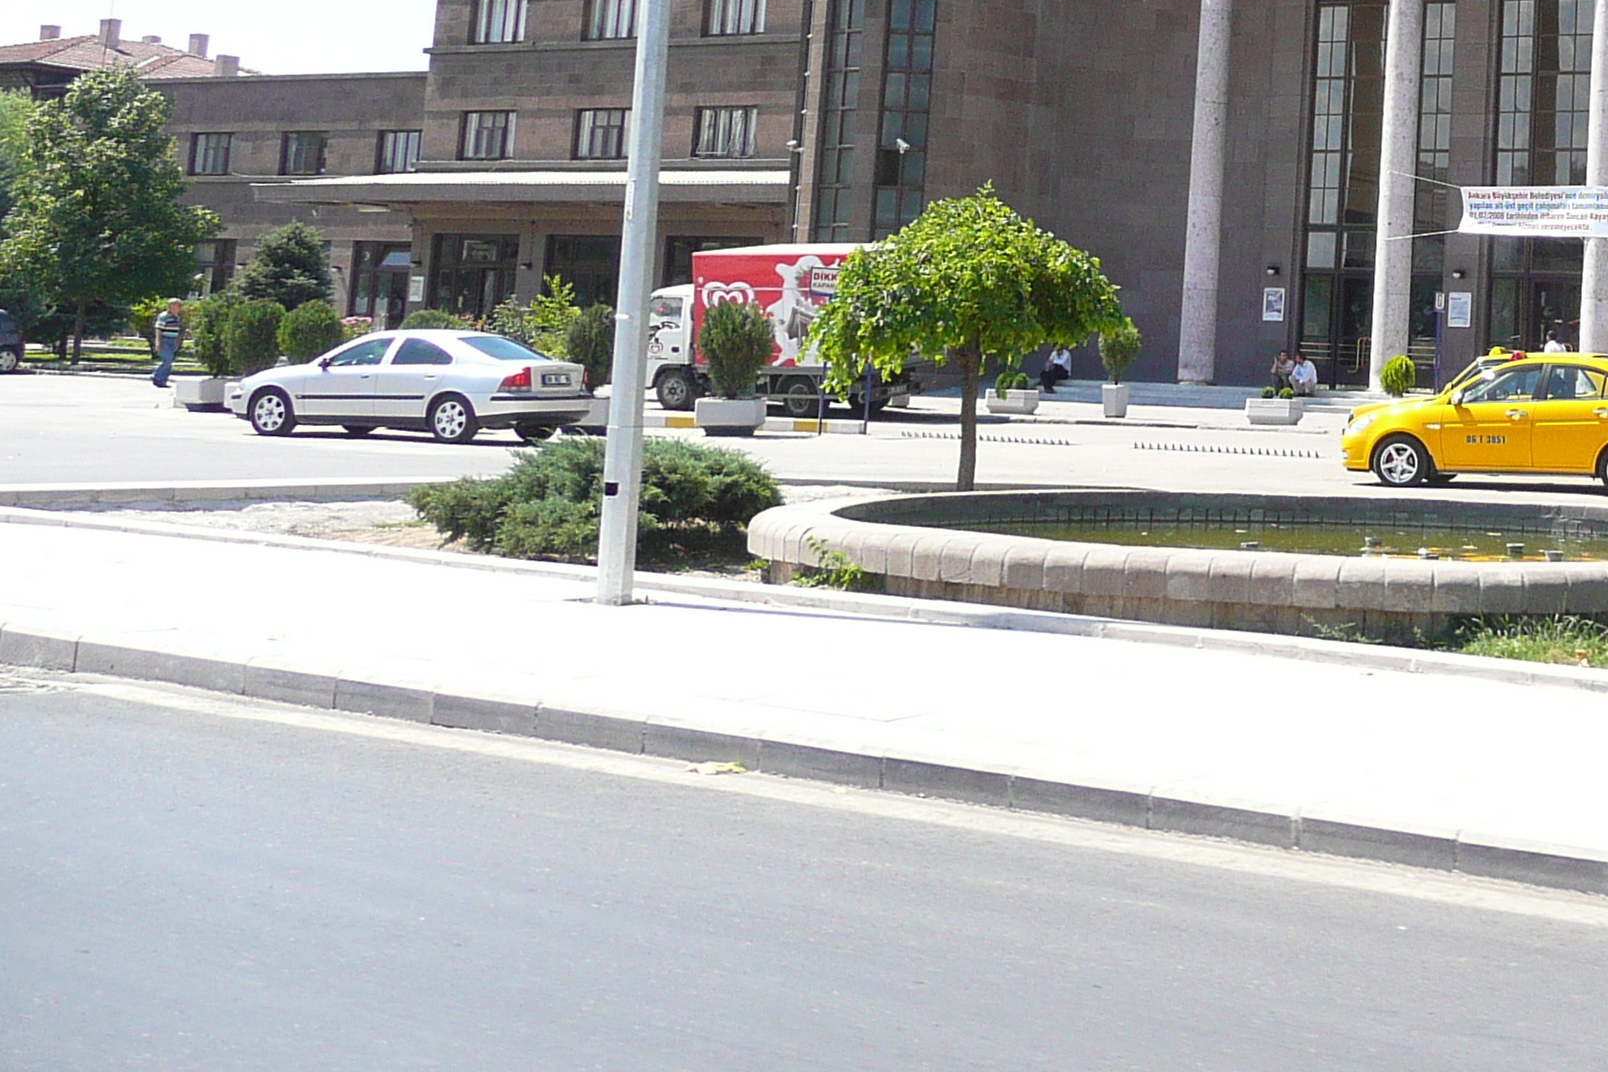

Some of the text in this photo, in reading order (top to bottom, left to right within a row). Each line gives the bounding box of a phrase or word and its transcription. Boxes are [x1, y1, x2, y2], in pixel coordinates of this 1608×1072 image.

[1468, 191, 1491, 200] Ankara
[1492, 191, 1528, 201] Büyükşehir
[814, 272, 837, 281] DİKK
[1479, 435, 1483, 443] T
